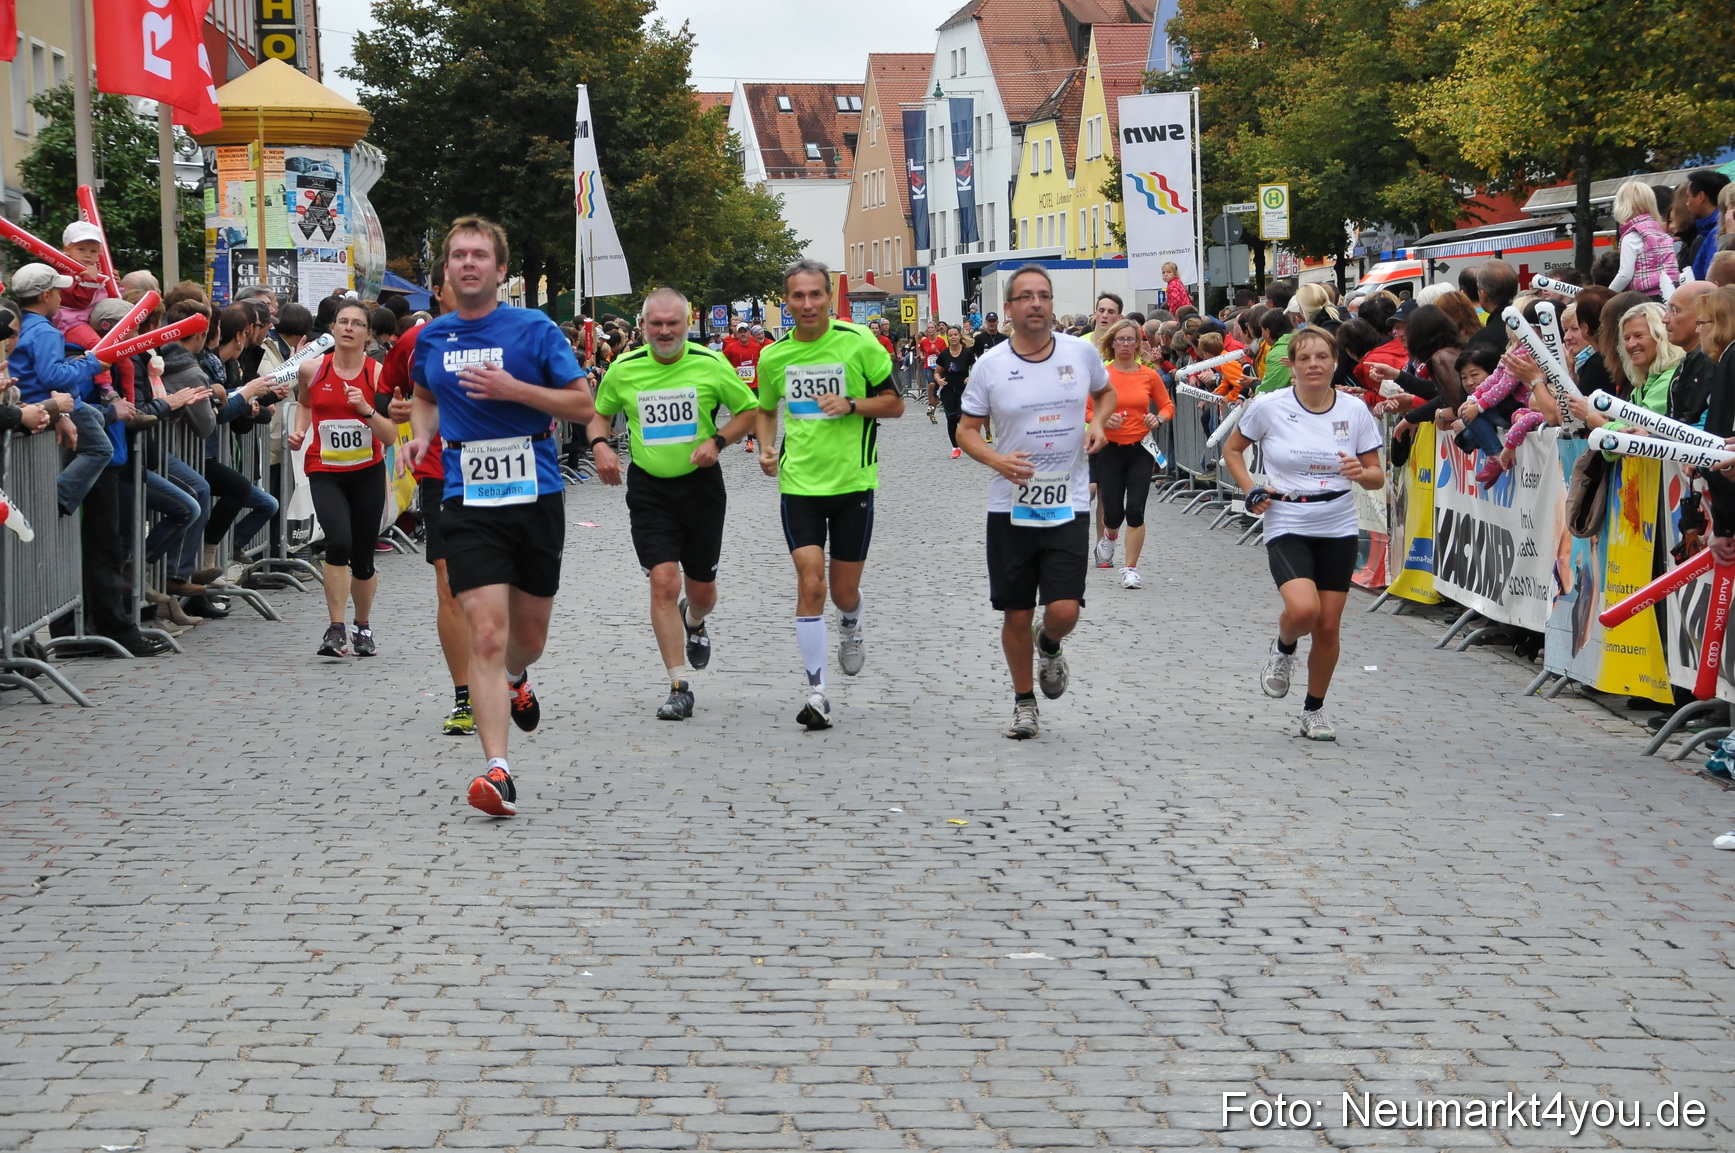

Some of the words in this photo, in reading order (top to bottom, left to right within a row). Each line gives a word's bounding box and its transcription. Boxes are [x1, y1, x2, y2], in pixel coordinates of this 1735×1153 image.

[1039, 193, 1053, 209] HOTEL
[1554, 281, 1580, 296] BMW
[905, 306, 914, 318] D
[116, 344, 136, 358] Audi
[137, 338, 155, 350] BKK
[443, 347, 504, 365] HUBER
[740, 369, 752, 377] 253
[806, 368, 835, 376] Neumarkt
[659, 393, 687, 401] Neumarkt
[791, 377, 840, 399] 3350
[644, 401, 693, 424] 3308
[1039, 414, 1061, 422] MERZ
[330, 430, 363, 449] 608
[486, 443, 521, 453] Neumarkt
[1627, 440, 1669, 459] BMW
[468, 453, 526, 481] 2911
[478, 485, 523, 497] Sebastian
[1018, 484, 1067, 505] 2260
[1685, 563, 1710, 583] Audi
[1662, 579, 1685, 597] BKK
[1718, 577, 1731, 606] Audi
[1713, 607, 1727, 632] BKK
